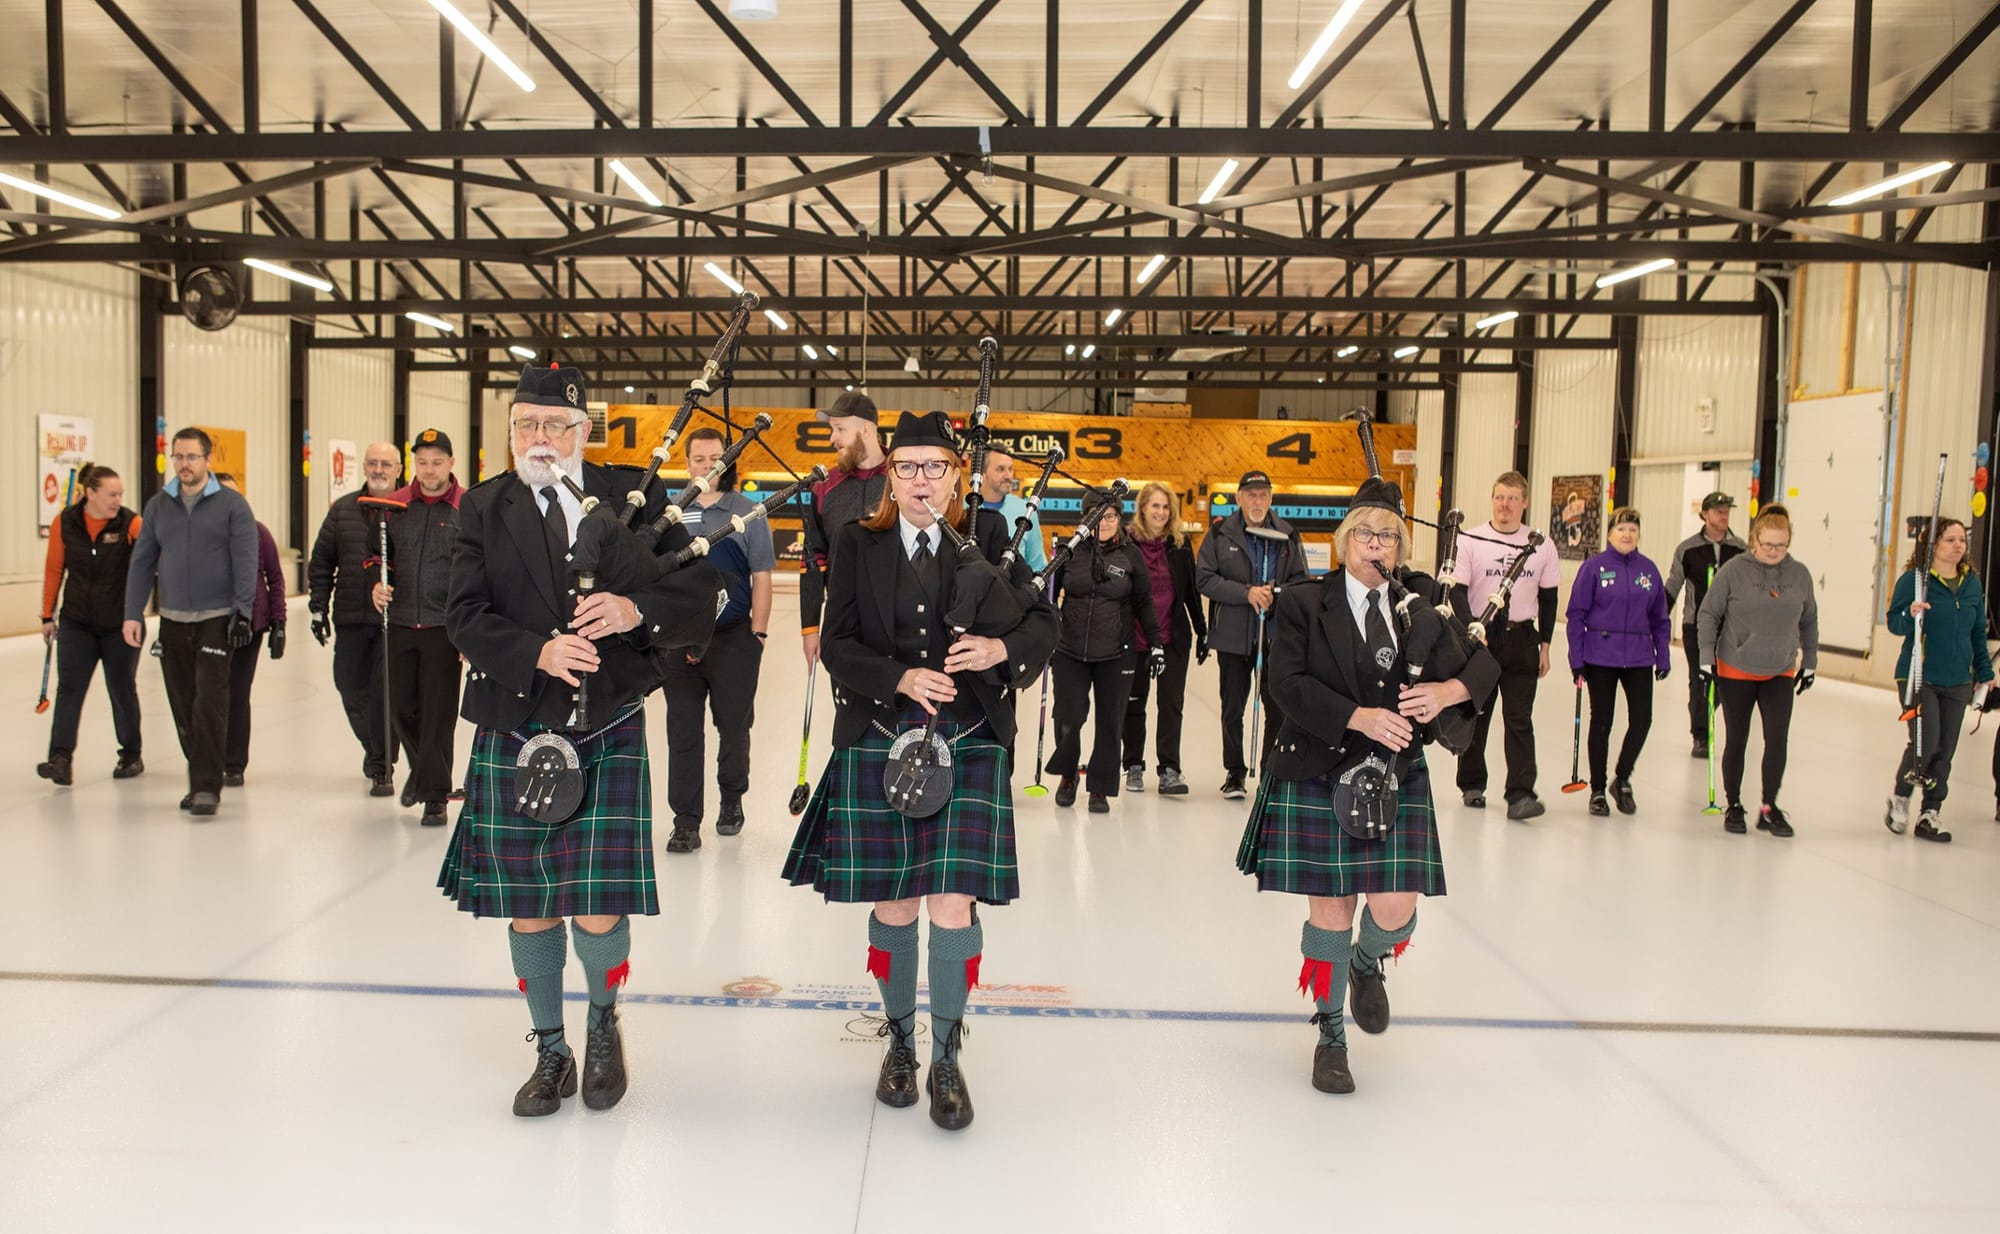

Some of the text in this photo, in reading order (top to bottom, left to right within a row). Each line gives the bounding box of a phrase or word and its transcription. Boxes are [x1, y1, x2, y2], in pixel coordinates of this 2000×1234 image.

[608, 417, 637, 449] 1
[1019, 435, 1061, 453] Club
[1074, 427, 1123, 460] 3
[1266, 432, 1317, 465] 4
[1485, 568, 1535, 577] EASON
[1038, 1007, 1149, 1020] CLUB
